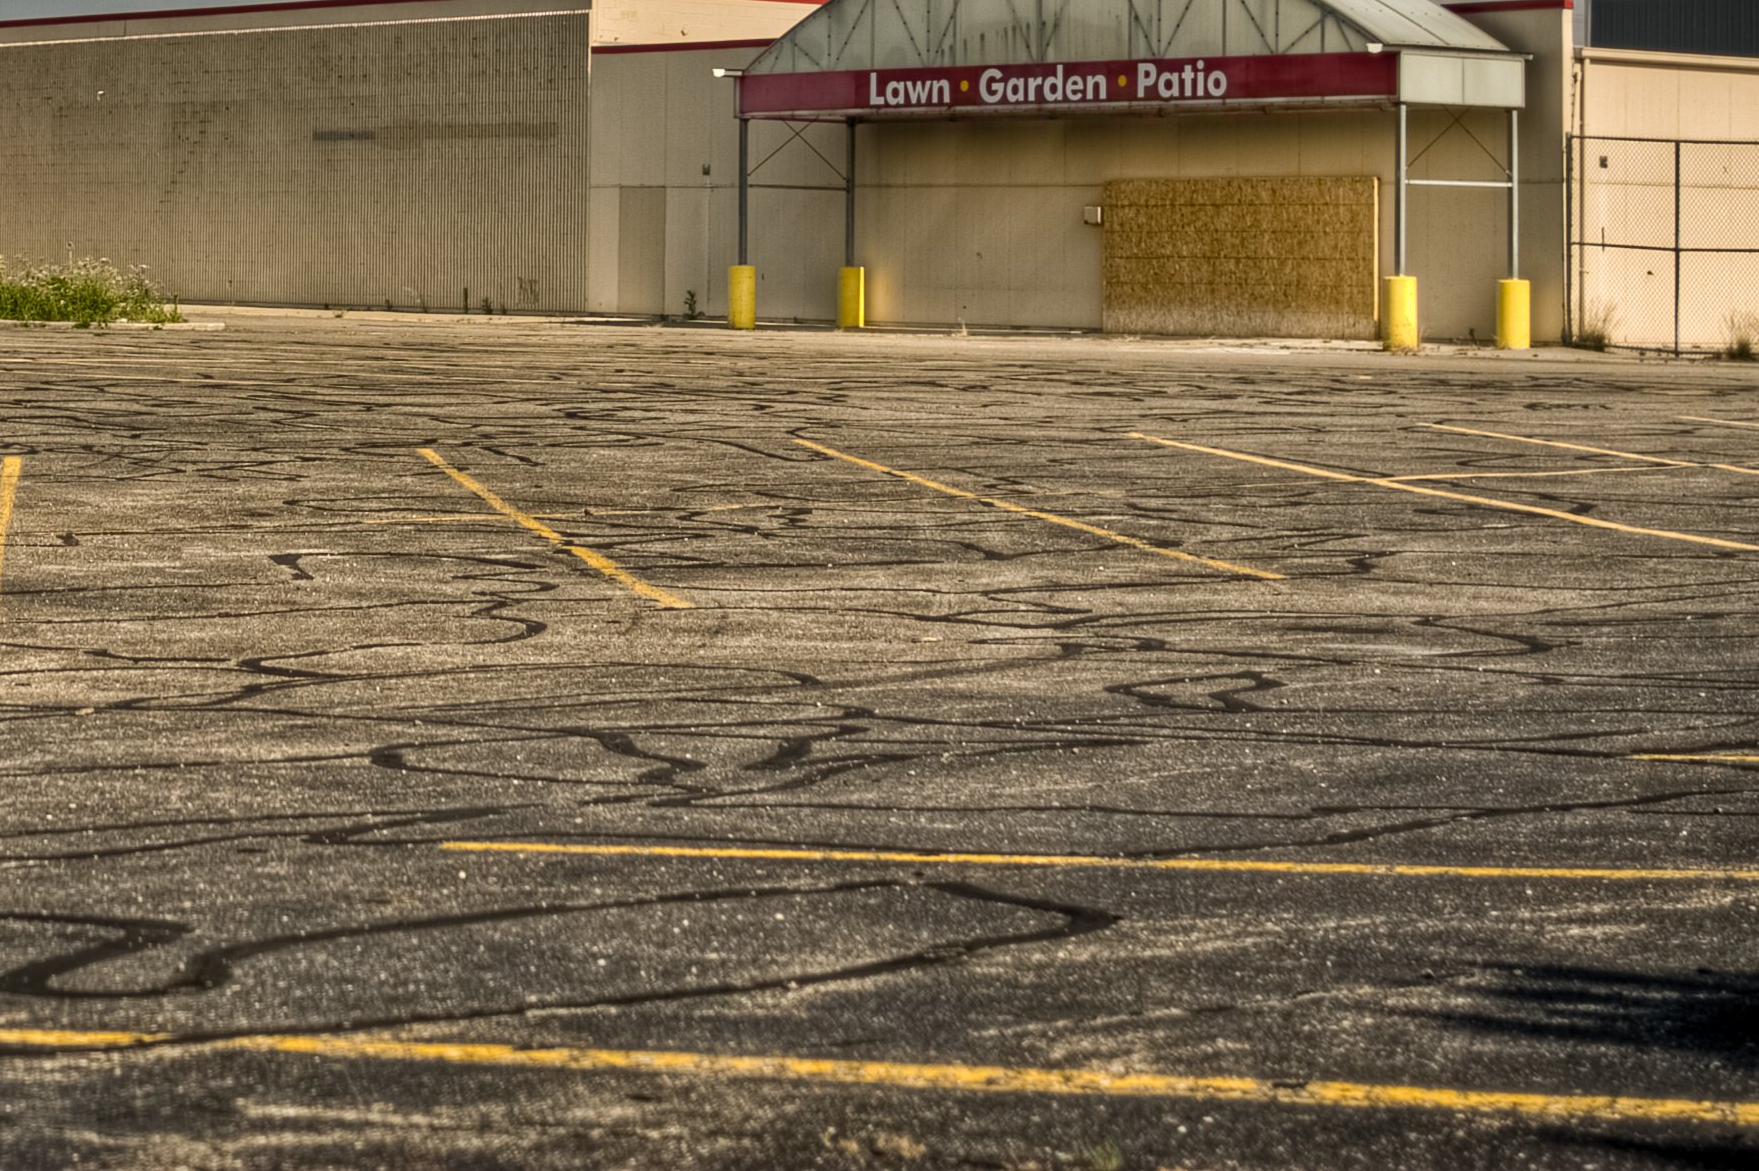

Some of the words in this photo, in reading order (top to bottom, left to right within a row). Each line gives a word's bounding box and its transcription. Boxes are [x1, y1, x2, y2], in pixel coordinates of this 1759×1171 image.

[869, 72, 951, 105] Lawn
[979, 65, 1107, 104] Garden
[1137, 60, 1228, 98] Patio
